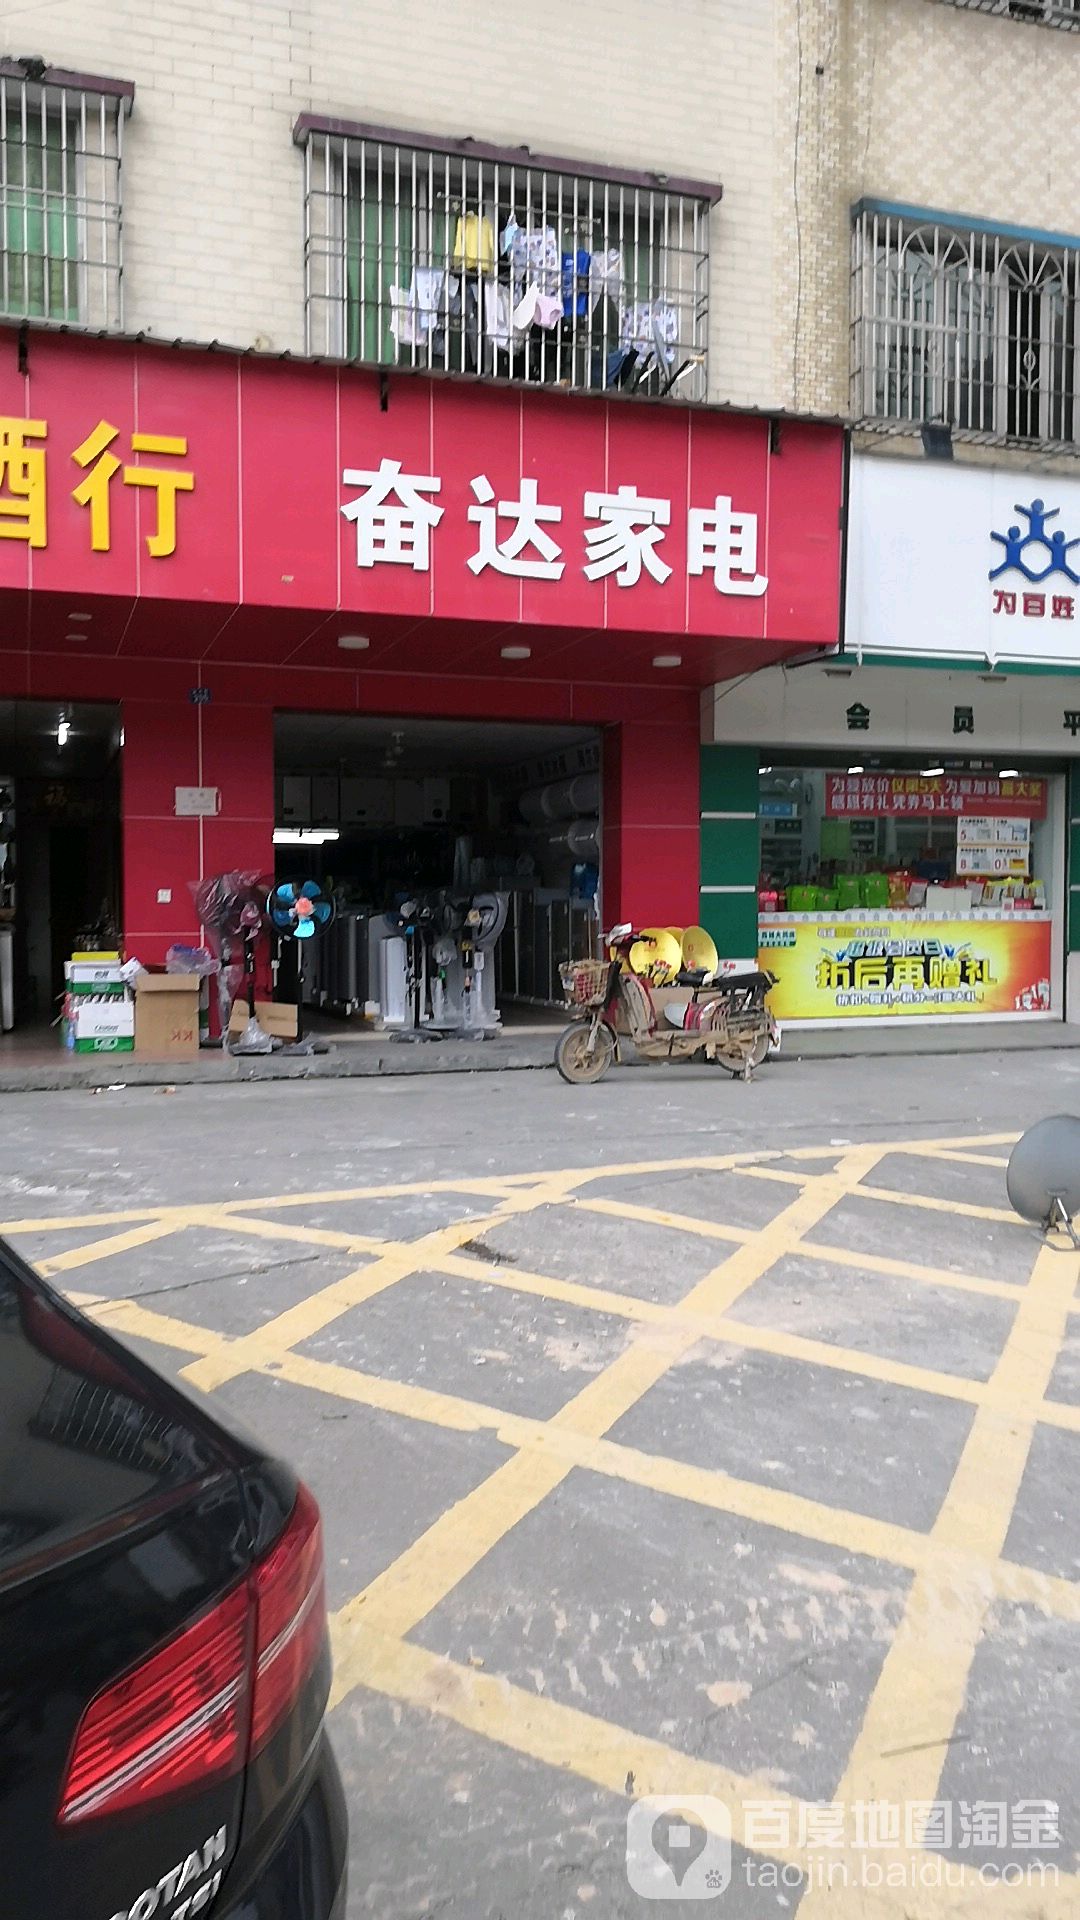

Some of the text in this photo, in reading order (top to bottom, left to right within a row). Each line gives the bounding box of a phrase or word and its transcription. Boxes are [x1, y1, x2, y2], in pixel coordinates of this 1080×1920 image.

[340, 458, 769, 597] 奋达家电
[993, 589, 1075, 620] 为百姓
[816, 956, 997, 990] 折后再赠礼
[109, 1824, 226, 1920] OTAN
